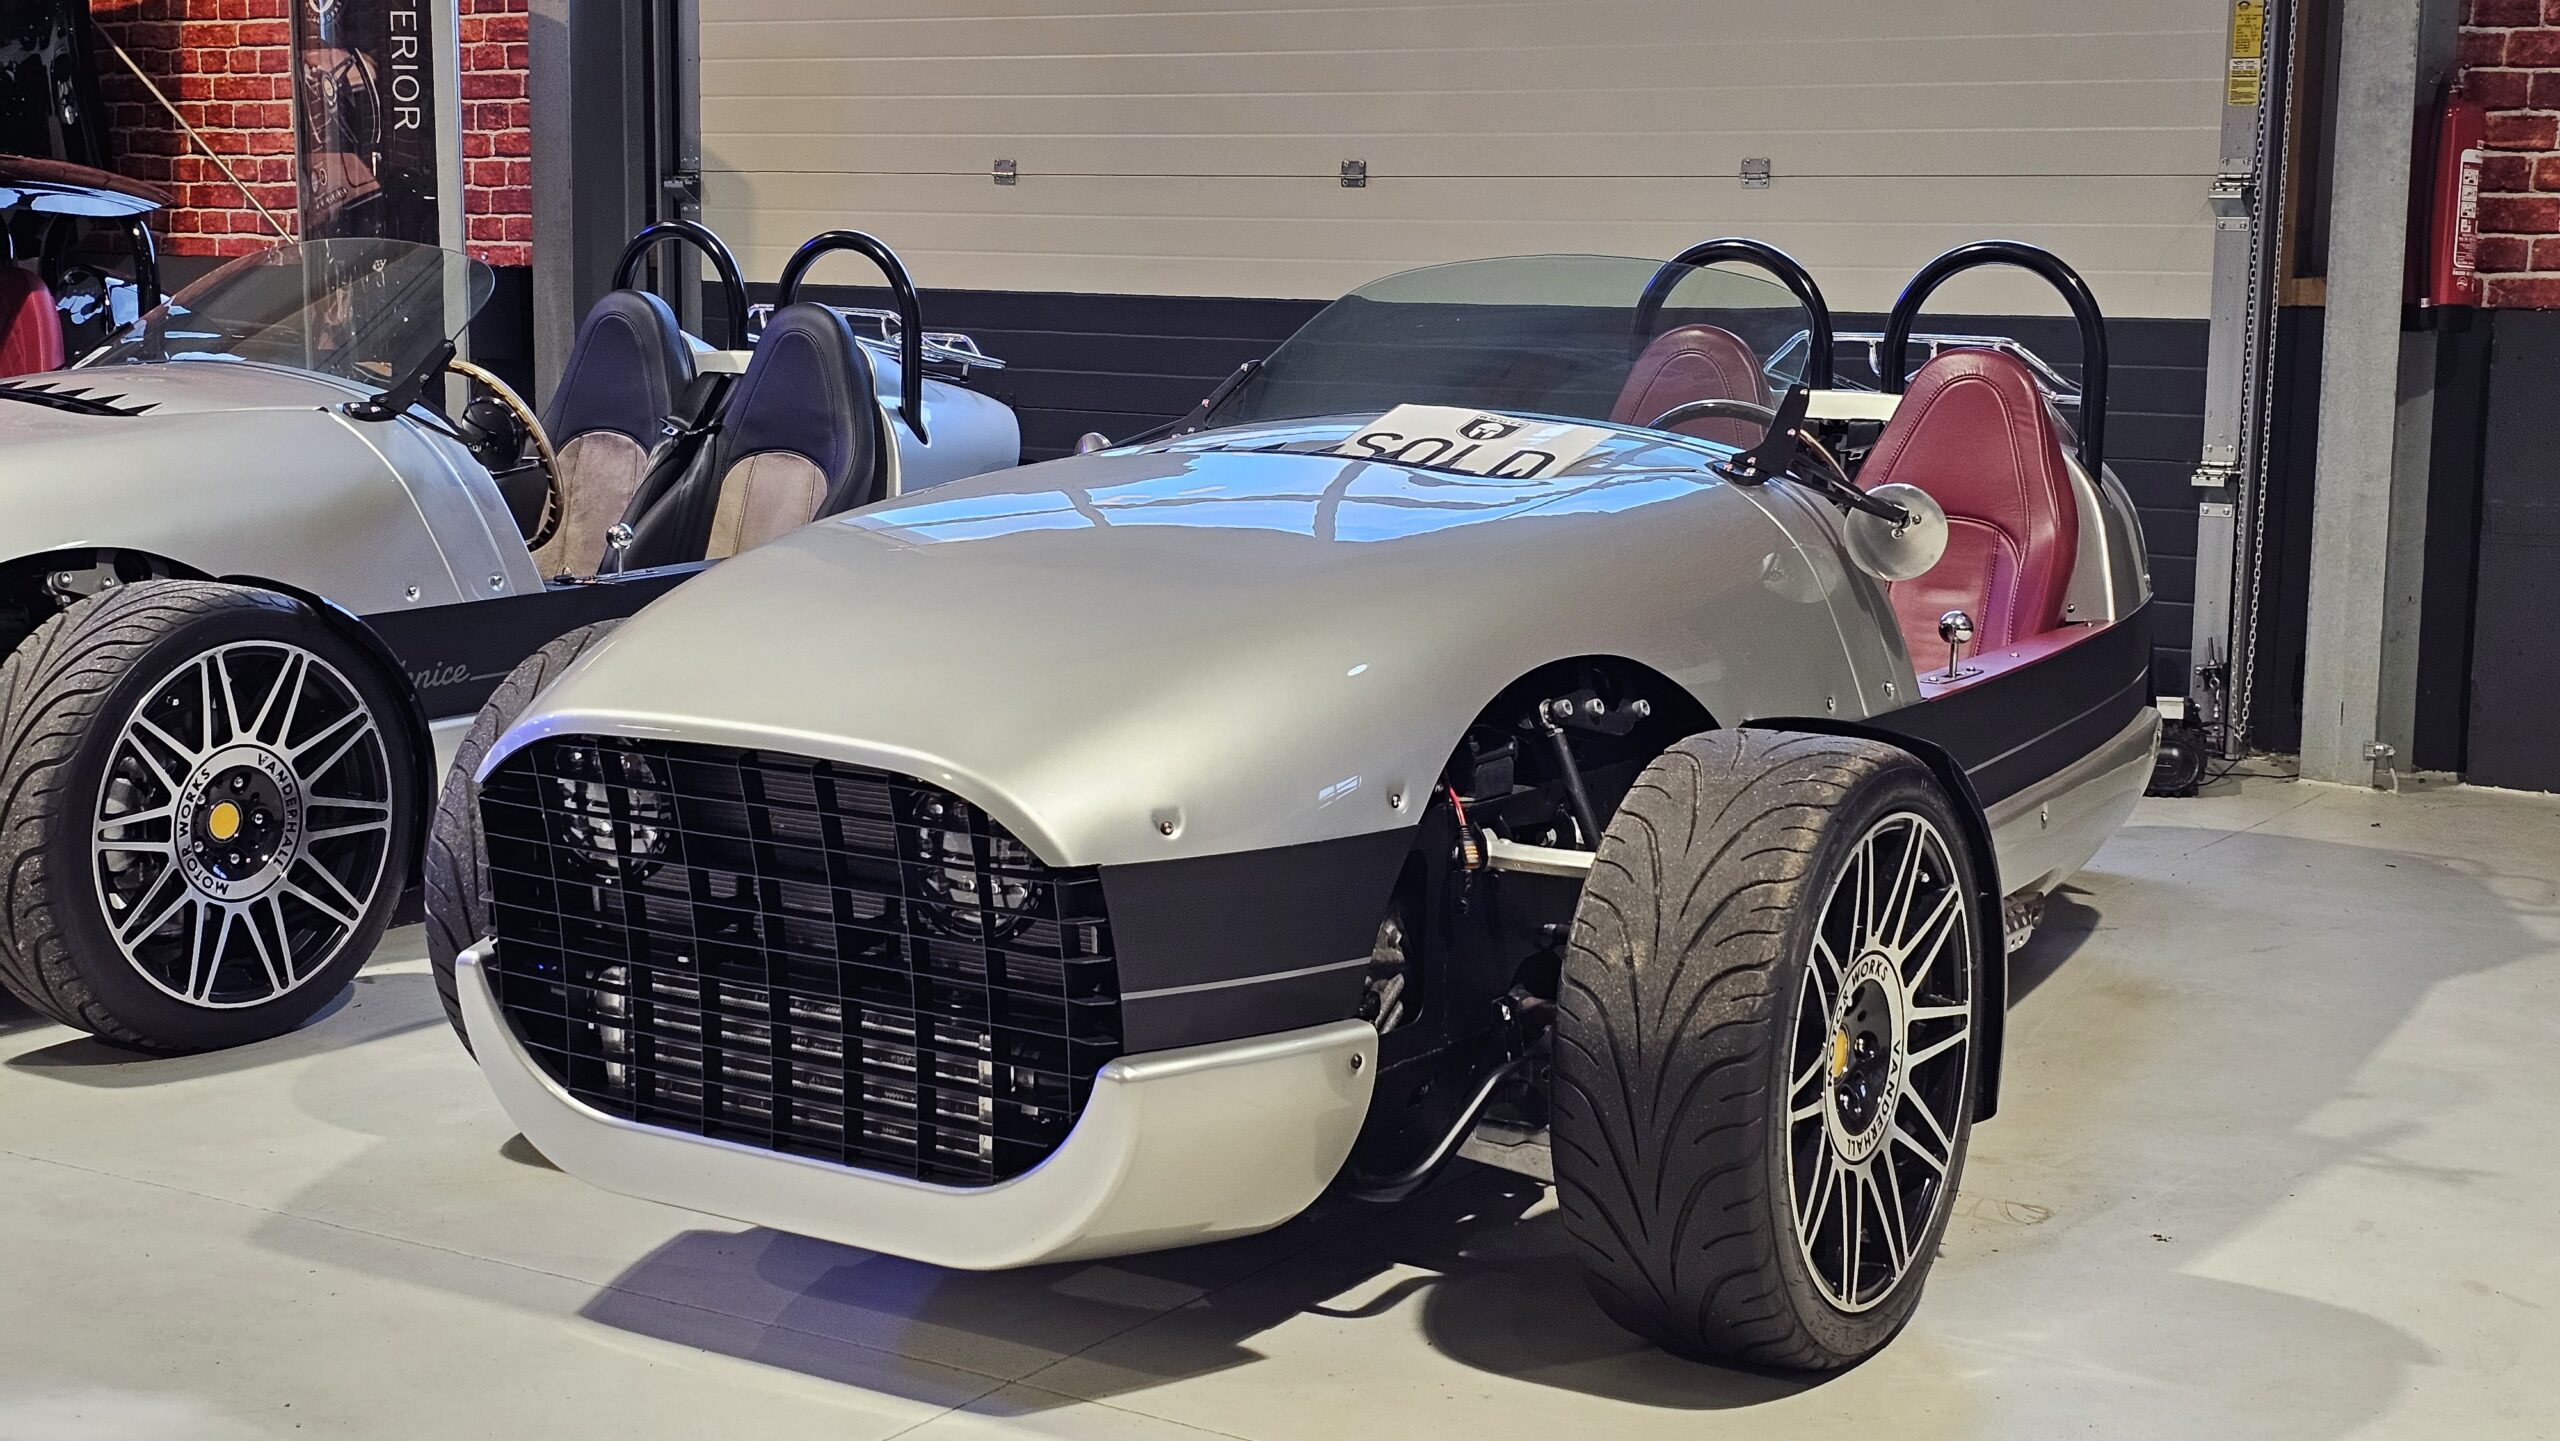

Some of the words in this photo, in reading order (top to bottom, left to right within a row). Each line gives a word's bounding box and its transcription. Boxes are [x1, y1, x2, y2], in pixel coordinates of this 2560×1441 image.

[390, 0, 421, 130] ERIOR
[178, 768, 211, 838] WORKS
[257, 753, 298, 867] VANDERHALL
[181, 844, 230, 896] MOTOR
[1851, 959, 1888, 988] WORKS
[1847, 1039, 1901, 1157] VANDERHALL
